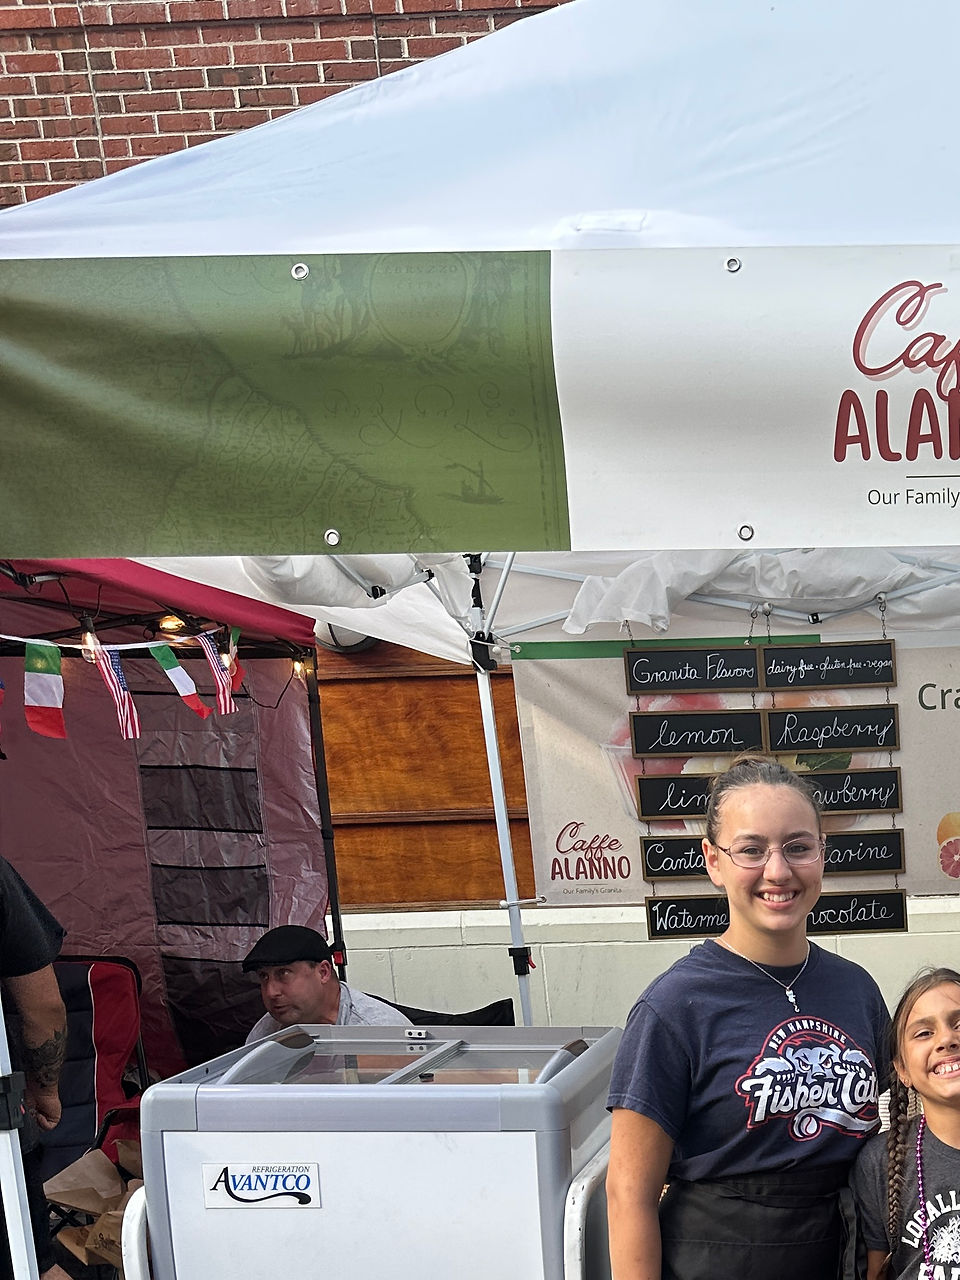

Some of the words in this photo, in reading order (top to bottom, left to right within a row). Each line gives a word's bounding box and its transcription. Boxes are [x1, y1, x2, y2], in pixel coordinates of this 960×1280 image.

[867, 489, 900, 505] Our
[632, 658, 702, 684] Granita
[706, 653, 755, 681] Flavors
[767, 659, 797, 683] dairy
[798, 659, 814, 679] free
[819, 656, 846, 679] gluten
[846, 658, 862, 676] free
[866, 659, 893, 675] vegan
[776, 713, 894, 748] Raspberry
[659, 782, 712, 811] lim
[555, 821, 624, 861] Caffe
[550, 856, 631, 880] ALANNO
[646, 842, 707, 872] Canta
[652, 902, 730, 931] Waterme
[768, 1030, 787, 1051] NEW
[787, 1019, 848, 1044] HAMPSHIRE
[741, 1074, 838, 1122] Fisher
[840, 1066, 878, 1113] Cat
[209, 1166, 311, 1196] AVANTCO
[251, 1165, 311, 1173] REFRIGERATION
